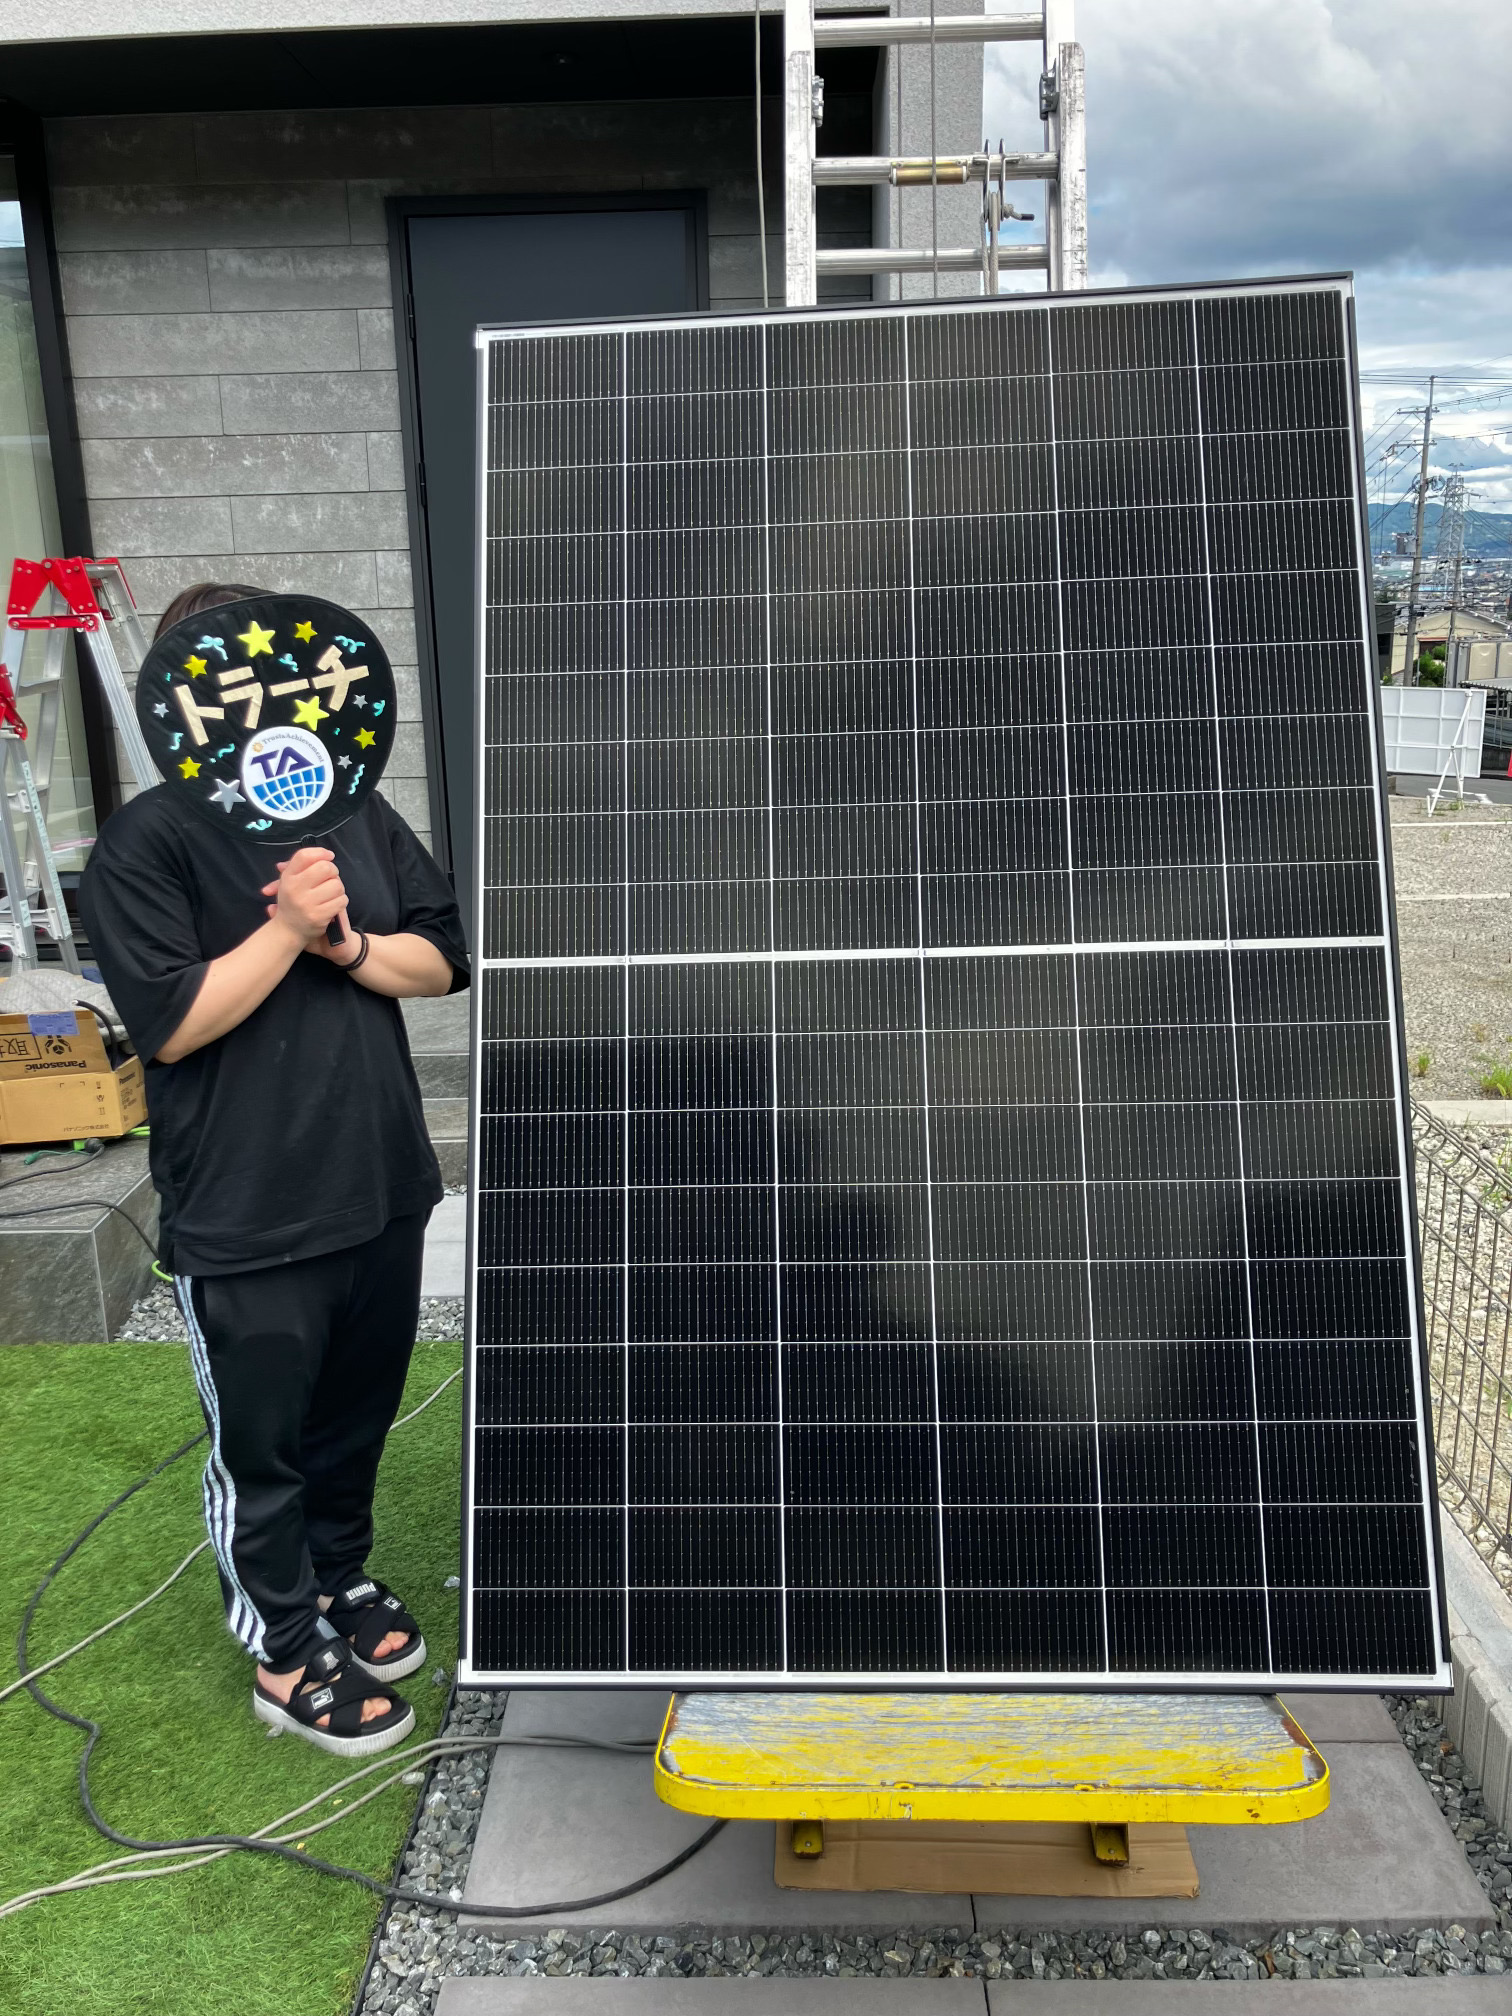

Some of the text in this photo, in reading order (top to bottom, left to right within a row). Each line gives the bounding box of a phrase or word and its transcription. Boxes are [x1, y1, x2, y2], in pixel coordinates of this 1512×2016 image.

[174, 644, 369, 746] トラーチ
[250, 746, 315, 780] TA
[0, 1038, 31, 1058] 取
[25, 1060, 87, 1072] Panasonic
[345, 1581, 377, 1601] PUMA
